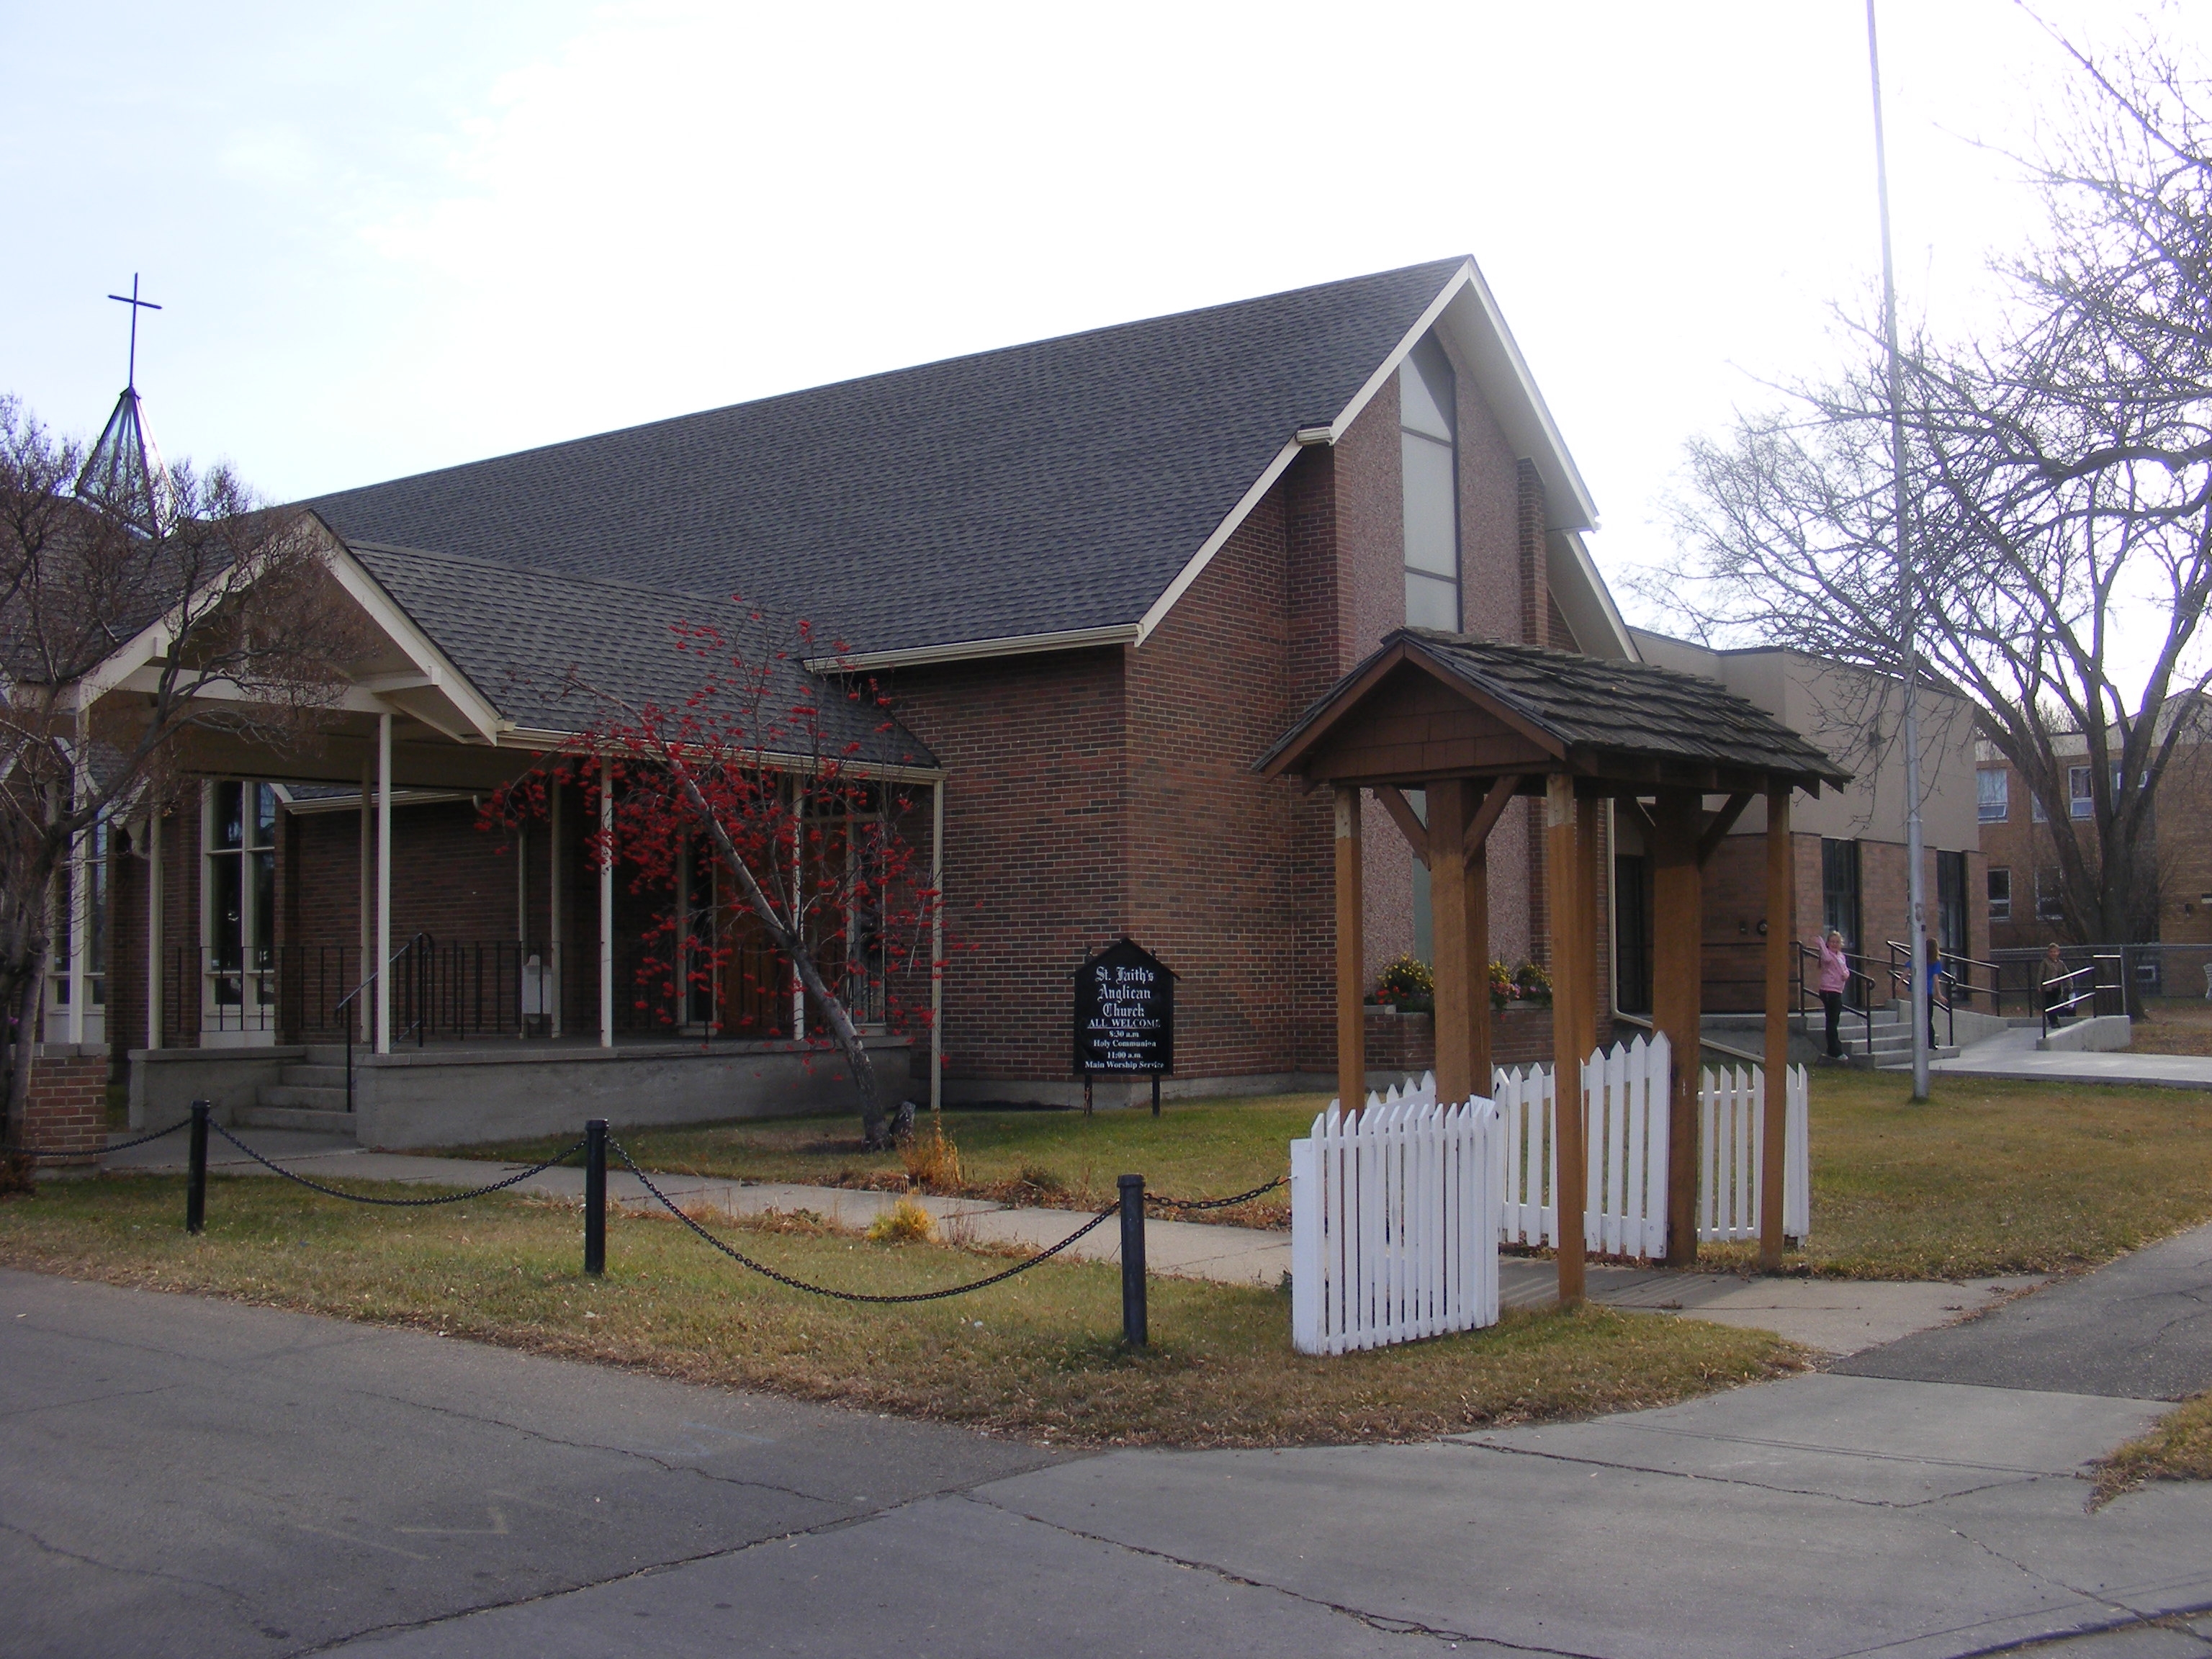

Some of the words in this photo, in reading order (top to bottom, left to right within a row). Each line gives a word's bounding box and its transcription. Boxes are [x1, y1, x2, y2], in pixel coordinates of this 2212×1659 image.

[1095, 966, 1111, 982] St.
[1115, 966, 1154, 985] Faith's
[1097, 984, 1151, 1003] Anglican
[1102, 1002, 1145, 1017] Church
[1088, 1018, 1107, 1028] ALL
[1093, 1039, 1110, 1048] Holy
[1106, 1061, 1138, 1070] Worship
